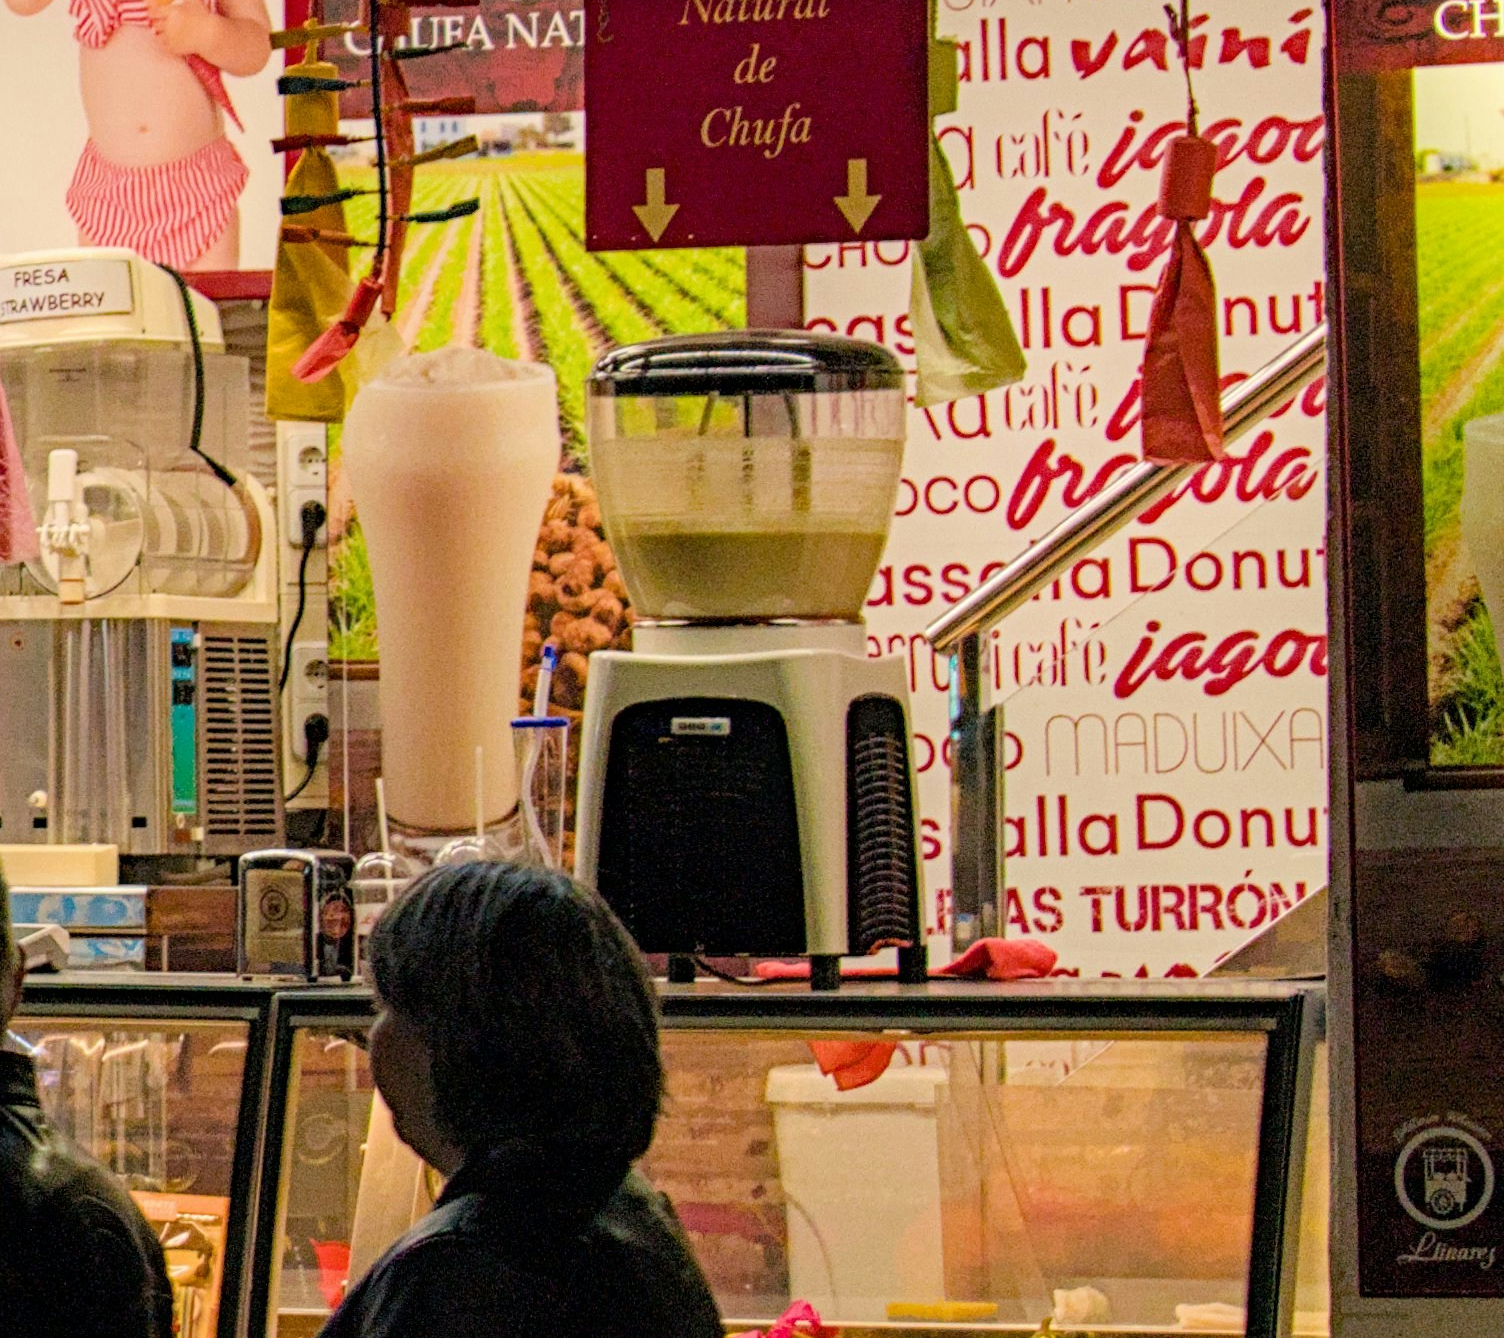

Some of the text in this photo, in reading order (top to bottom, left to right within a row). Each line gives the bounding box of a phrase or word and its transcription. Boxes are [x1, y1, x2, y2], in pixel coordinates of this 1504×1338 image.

[343, 11, 494, 57] CUFA
[733, 43, 777, 85] de
[700, 101, 813, 160] Chufa
[995, 108, 1091, 181] café
[0, 291, 106, 318] STRAWBERRY
[14, 267, 71, 288] FRESA
[1012, 615, 1107, 688] café
[1044, 707, 1326, 777] MADUIXA
[1135, 793, 1327, 852] Donu
[1079, 869, 1307, 934] TURRÓN
